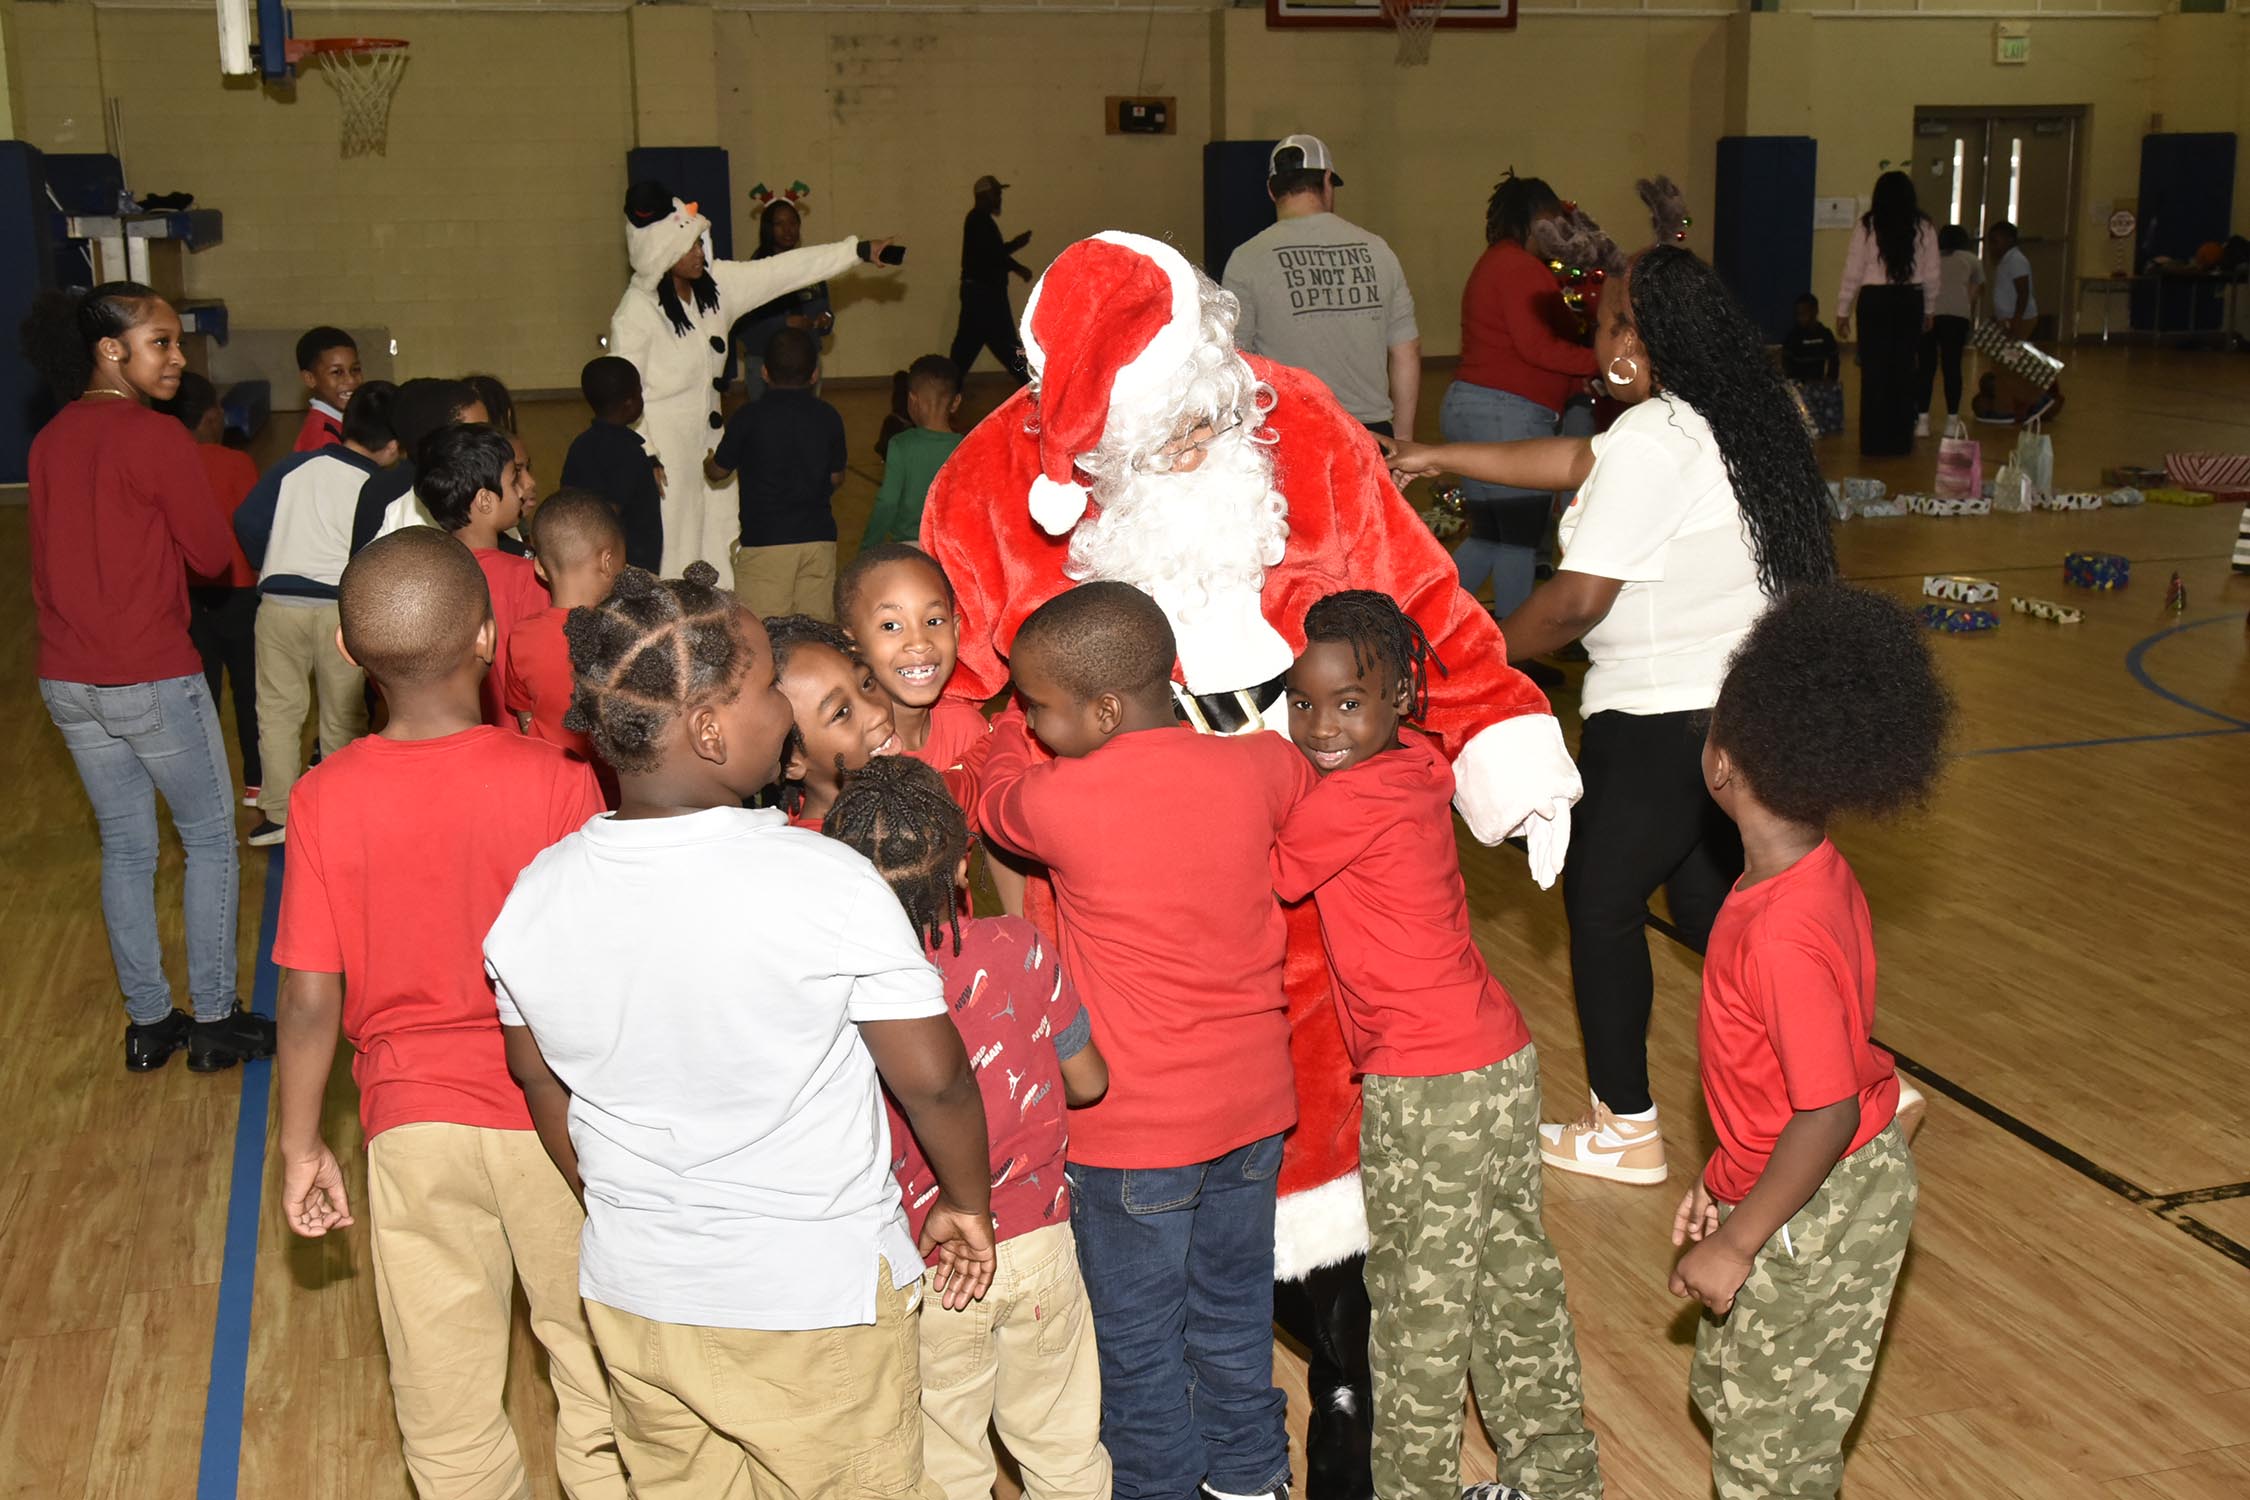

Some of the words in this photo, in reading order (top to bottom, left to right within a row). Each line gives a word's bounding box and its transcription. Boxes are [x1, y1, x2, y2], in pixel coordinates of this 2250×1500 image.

[1278, 247, 1372, 270] QUITTING
[1283, 269, 1306, 289] IS
[1311, 267, 1345, 286] NOT
[1351, 265, 1377, 284] AN
[1290, 285, 1380, 309] OPTION
[980, 1040, 1004, 1069] MAN
